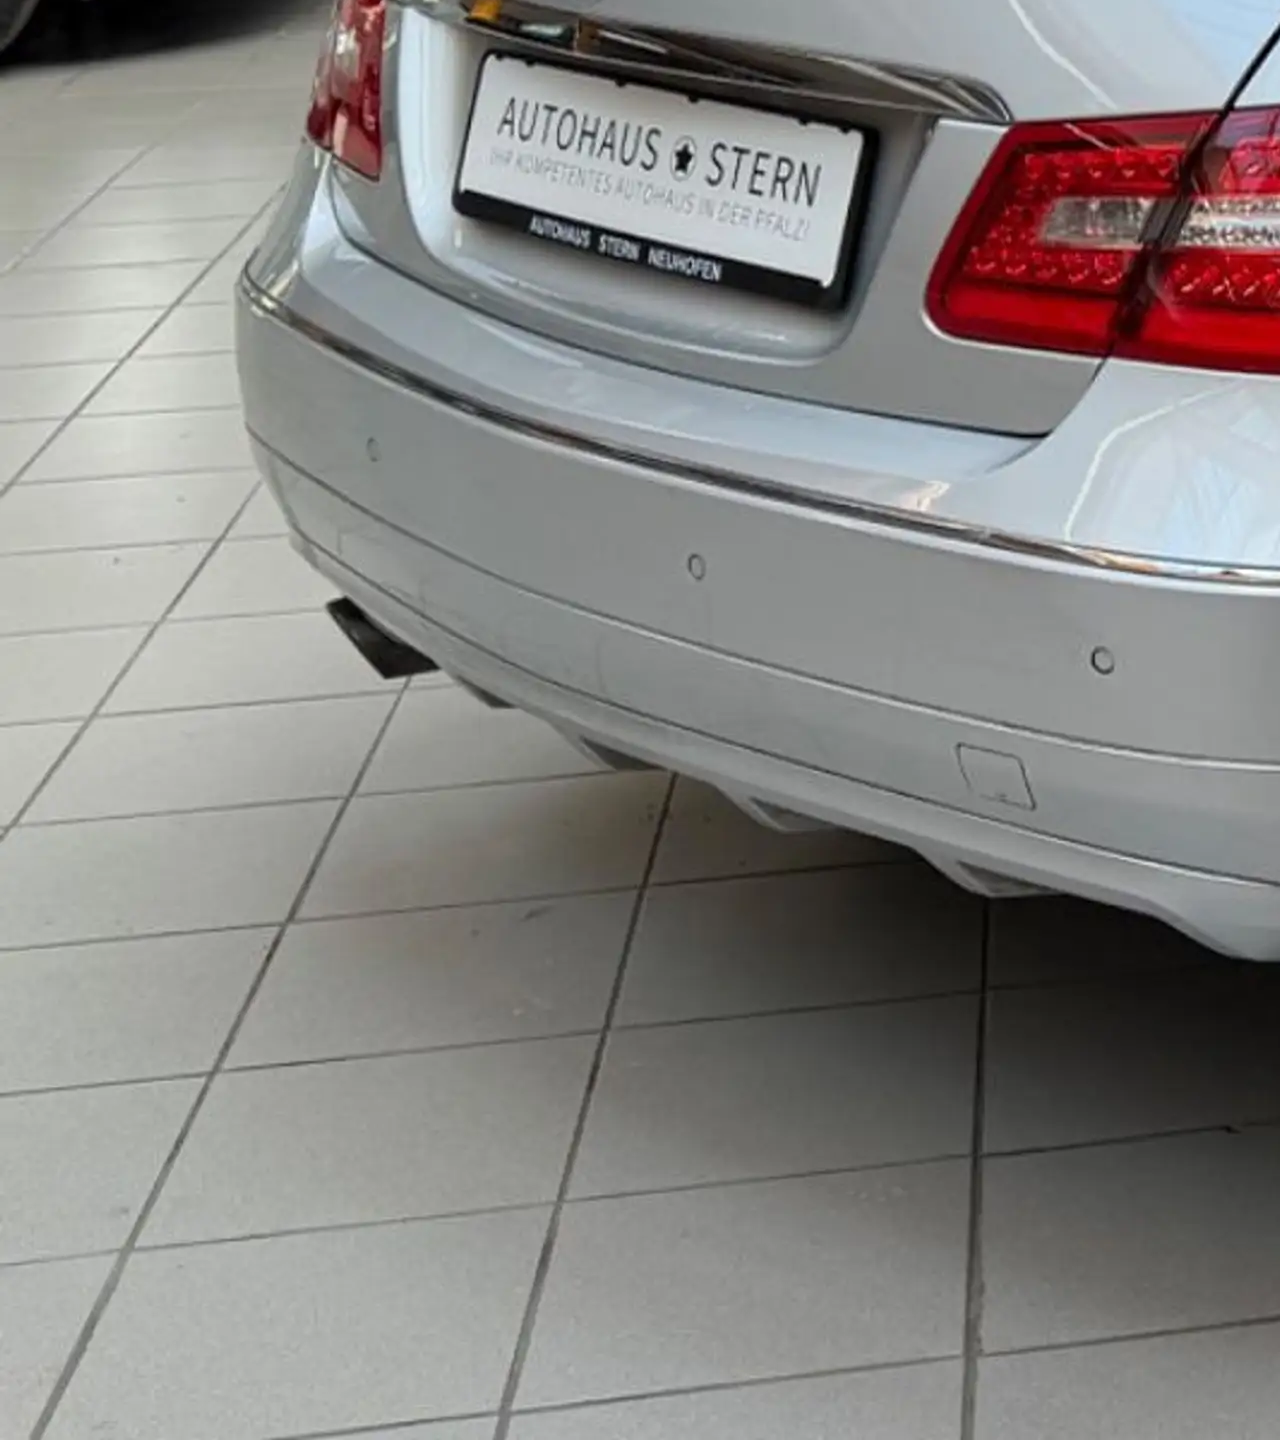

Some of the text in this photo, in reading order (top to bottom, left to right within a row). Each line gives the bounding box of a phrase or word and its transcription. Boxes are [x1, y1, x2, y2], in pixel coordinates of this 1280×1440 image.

[497, 97, 822, 207] AUTOHAUS STERN
[515, 151, 612, 194] KOMPETENTES
[614, 175, 697, 215] AUTOHAUS
[699, 198, 714, 220] IN
[716, 199, 752, 227] DER
[528, 214, 723, 281] AUTOHAUS STERN NEUHOFEN
